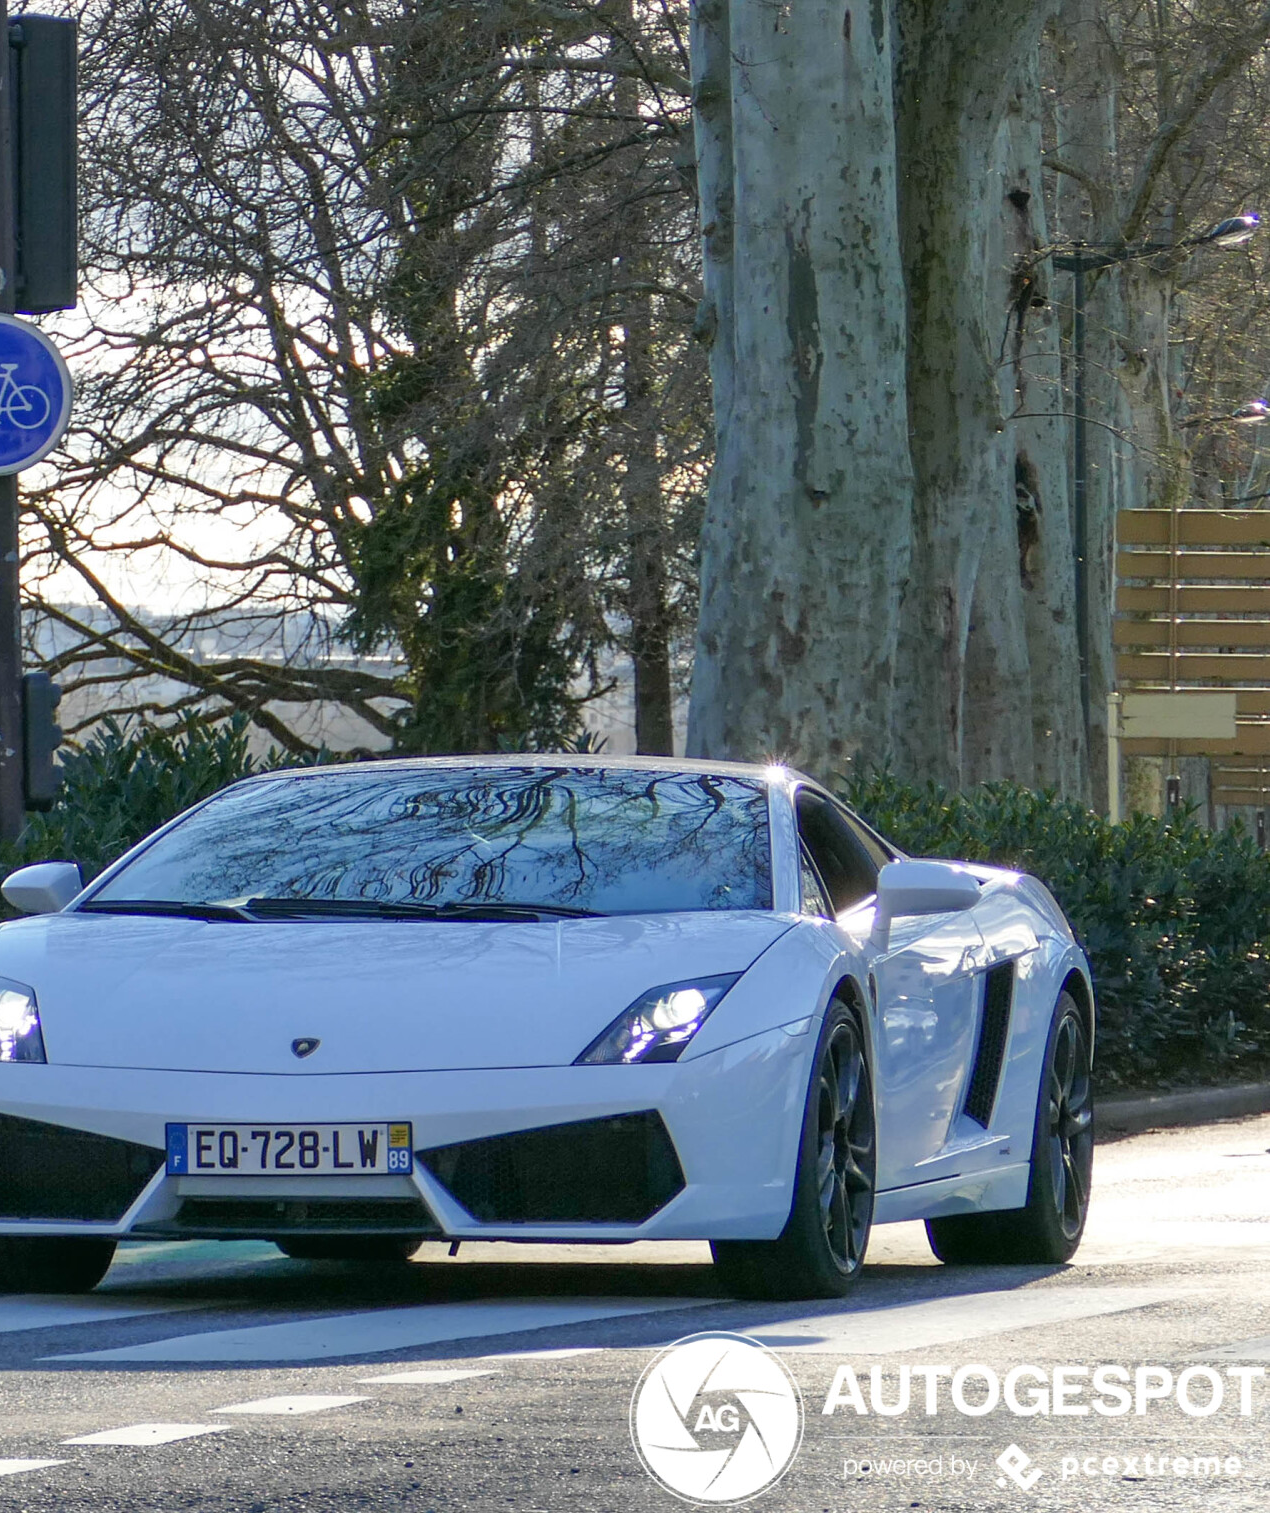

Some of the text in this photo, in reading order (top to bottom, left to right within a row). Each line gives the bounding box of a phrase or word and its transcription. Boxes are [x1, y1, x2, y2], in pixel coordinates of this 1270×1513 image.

[196, 1130, 379, 1169] EQ-728-LW
[174, 1155, 182, 1167] F
[389, 1150, 409, 1169] 89
